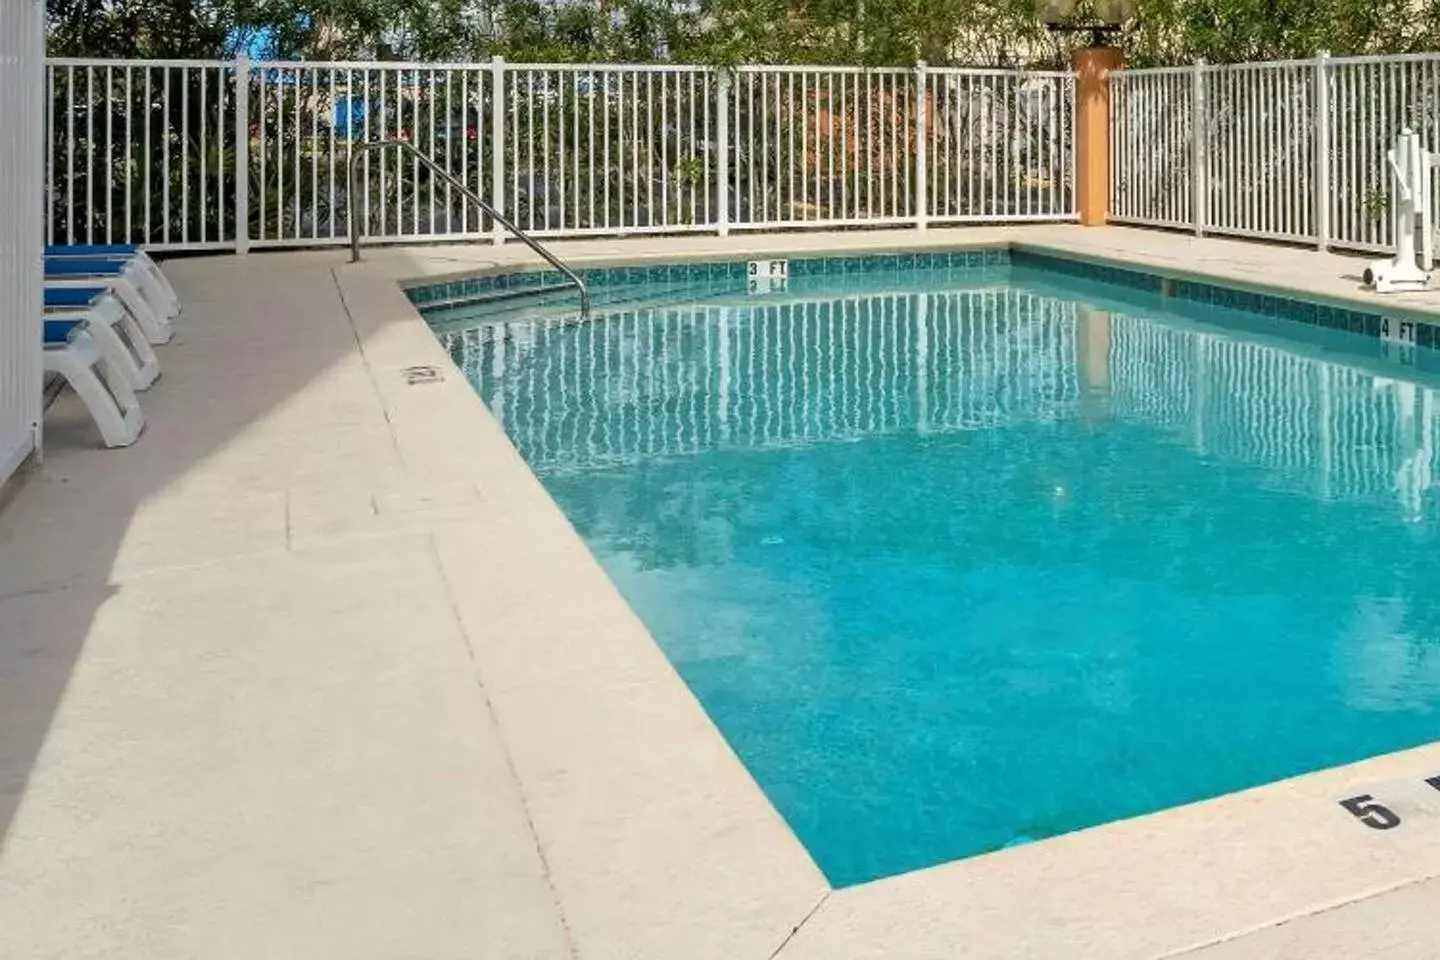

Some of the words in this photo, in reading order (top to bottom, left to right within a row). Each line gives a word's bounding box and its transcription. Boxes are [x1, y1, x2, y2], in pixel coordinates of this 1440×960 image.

[749, 262, 758, 275] 3
[769, 260, 786, 275] FT
[1381, 318, 1389, 337] 4
[1399, 322, 1414, 342] FT
[1338, 794, 1401, 830] 5
